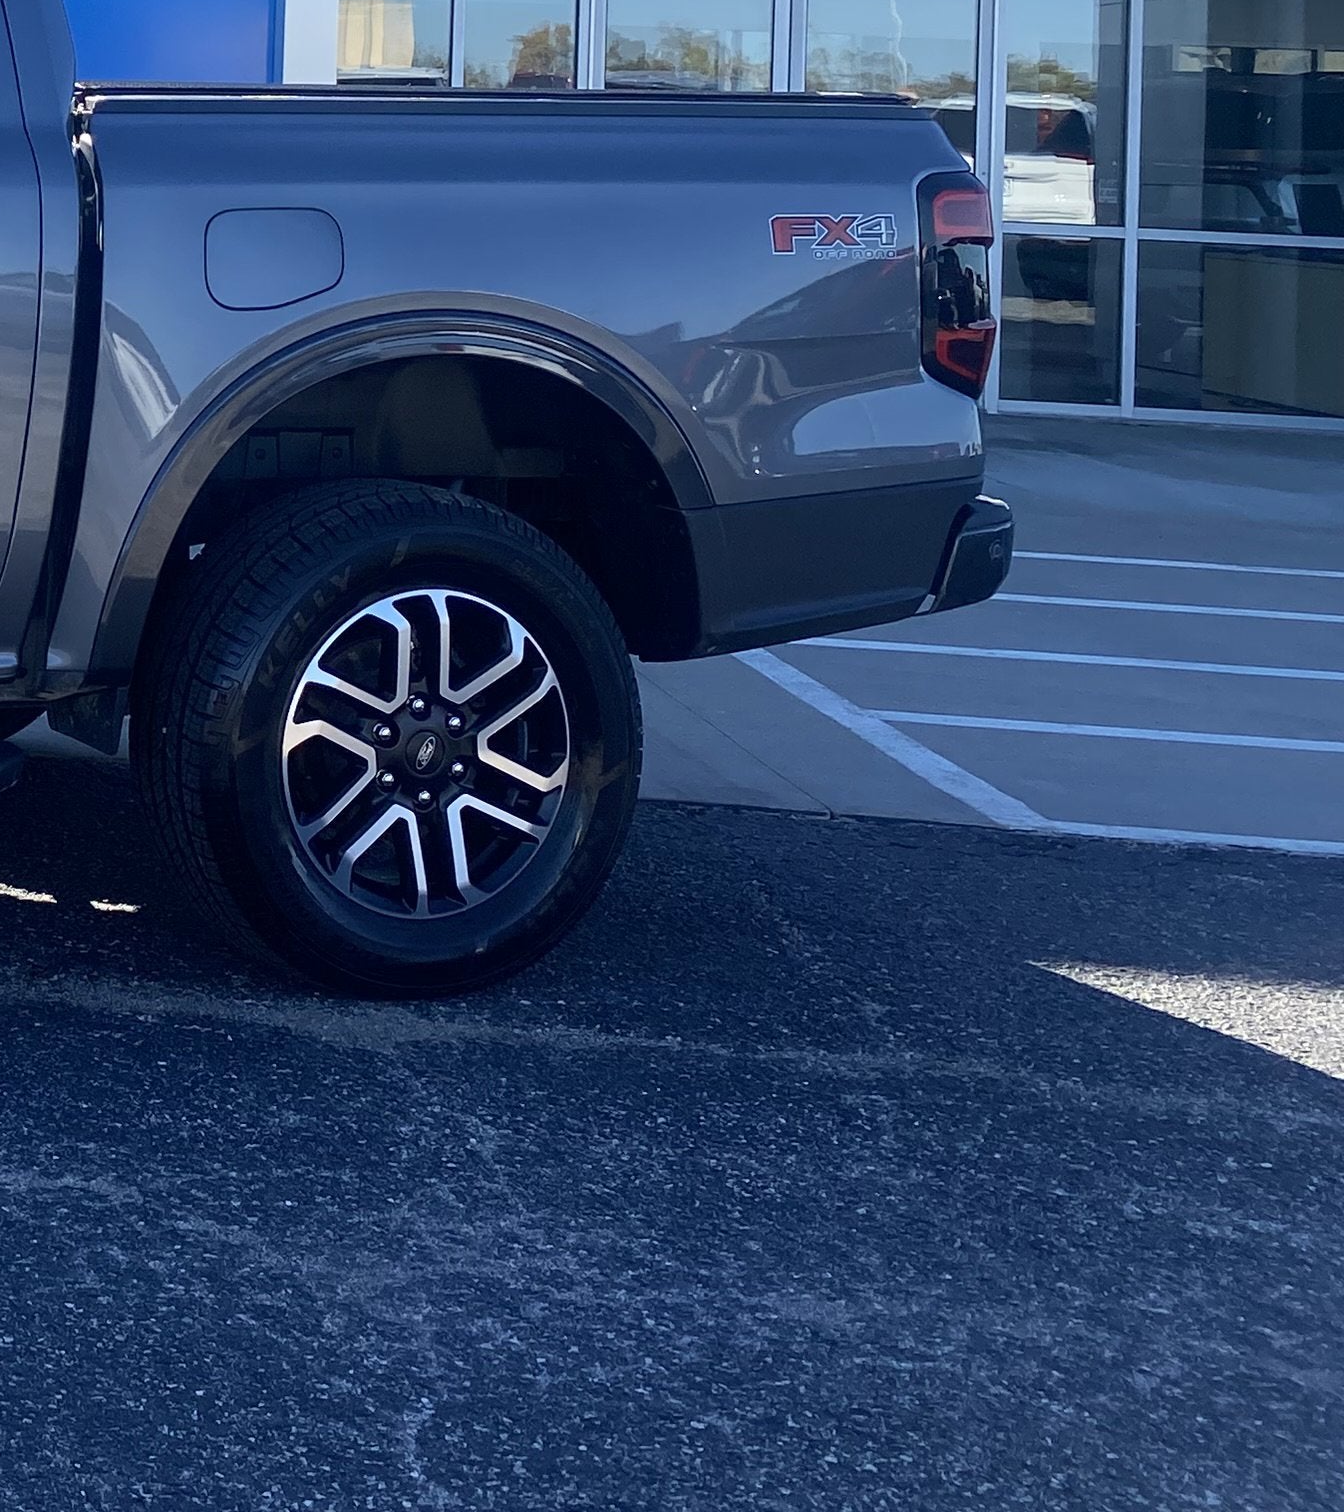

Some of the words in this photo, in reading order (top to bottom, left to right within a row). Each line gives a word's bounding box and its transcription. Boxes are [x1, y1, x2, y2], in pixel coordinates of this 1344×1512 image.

[768, 214, 898, 255] FX4
[813, 249, 848, 260] OFF
[852, 249, 897, 260] ROAD
